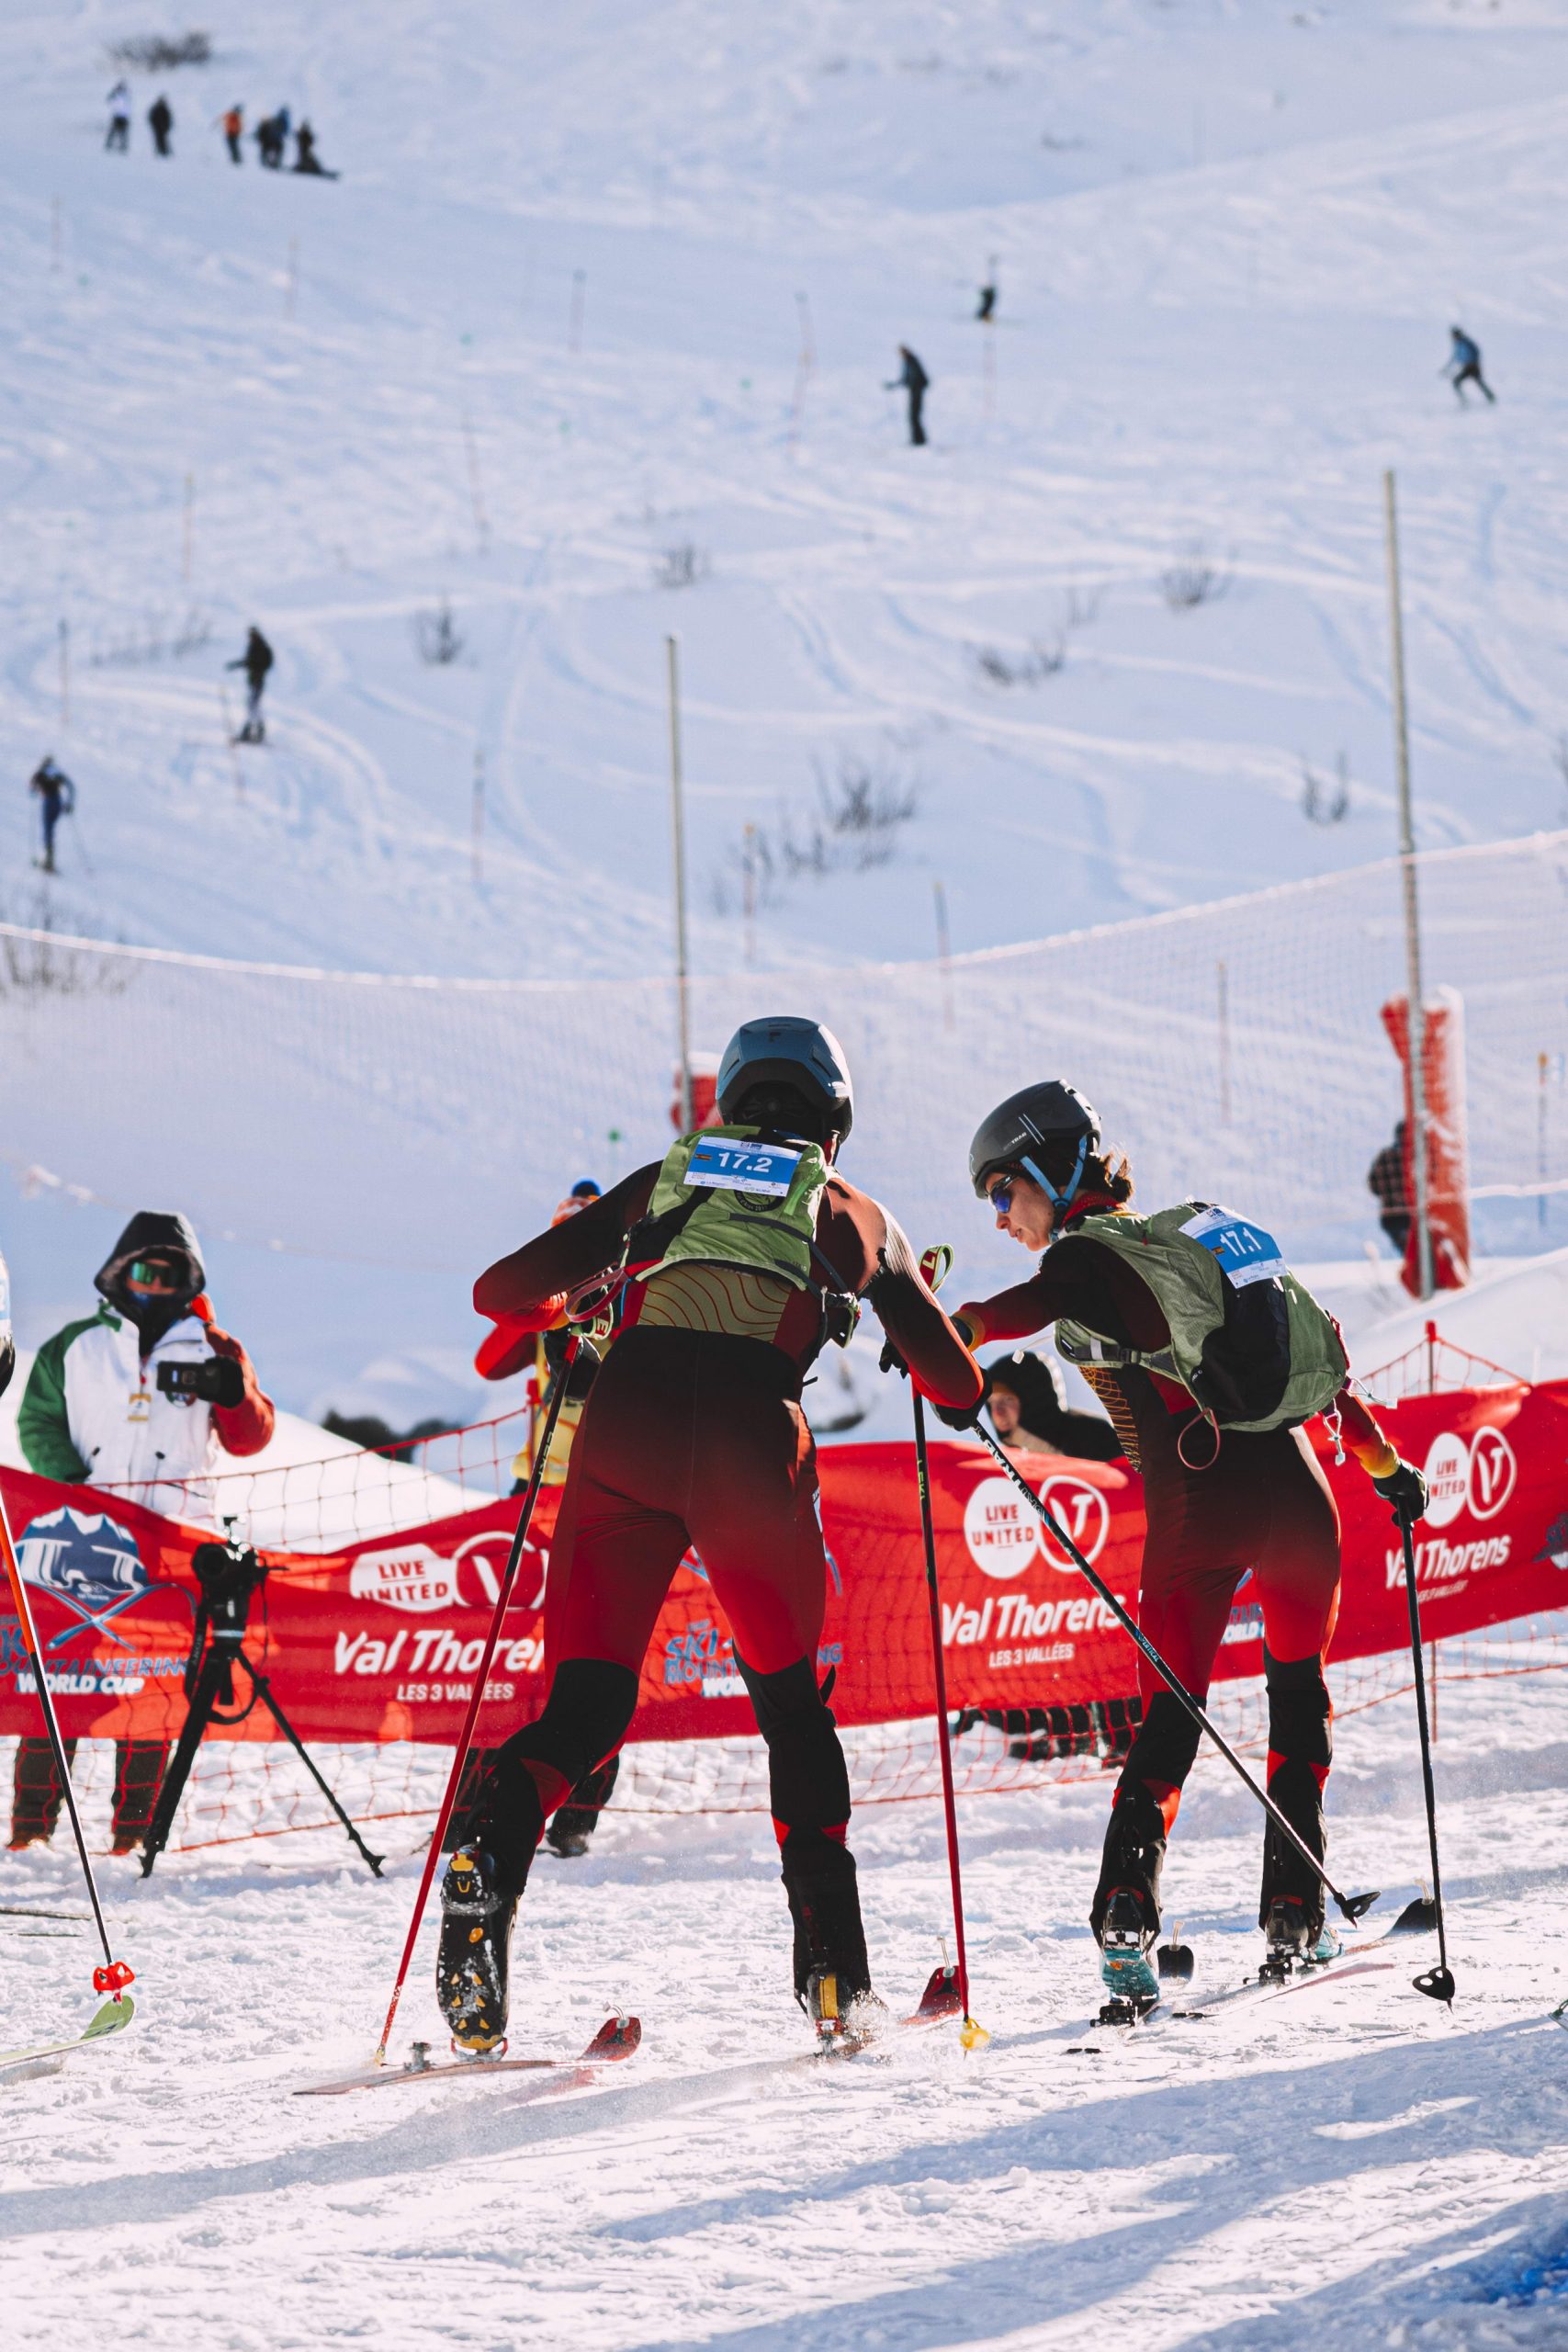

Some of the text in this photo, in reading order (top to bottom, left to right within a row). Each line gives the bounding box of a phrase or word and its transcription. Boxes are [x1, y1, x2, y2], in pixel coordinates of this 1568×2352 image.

[718, 1152, 773, 1173] 17.2
[1220, 1227, 1262, 1257] 17.1
[1436, 1458, 1459, 1476] LIVE
[1428, 1479, 1466, 1498] NITED
[986, 1504, 1019, 1521] LIVE
[972, 1526, 1035, 1547] UNITED
[378, 1560, 425, 1581] LIVE
[1385, 1543, 1425, 1590] Val
[1423, 1534, 1513, 1581] Thorens
[942, 1593, 1127, 1646] Val Thorens
[333, 1630, 409, 1675] Val
[666, 1628, 718, 1661] SKI
[988, 1640, 1076, 1668] LES 3 VALLÉES
[99, 1676, 145, 1694] CUP
[396, 1679, 515, 1702] LES 3 VALÉES
